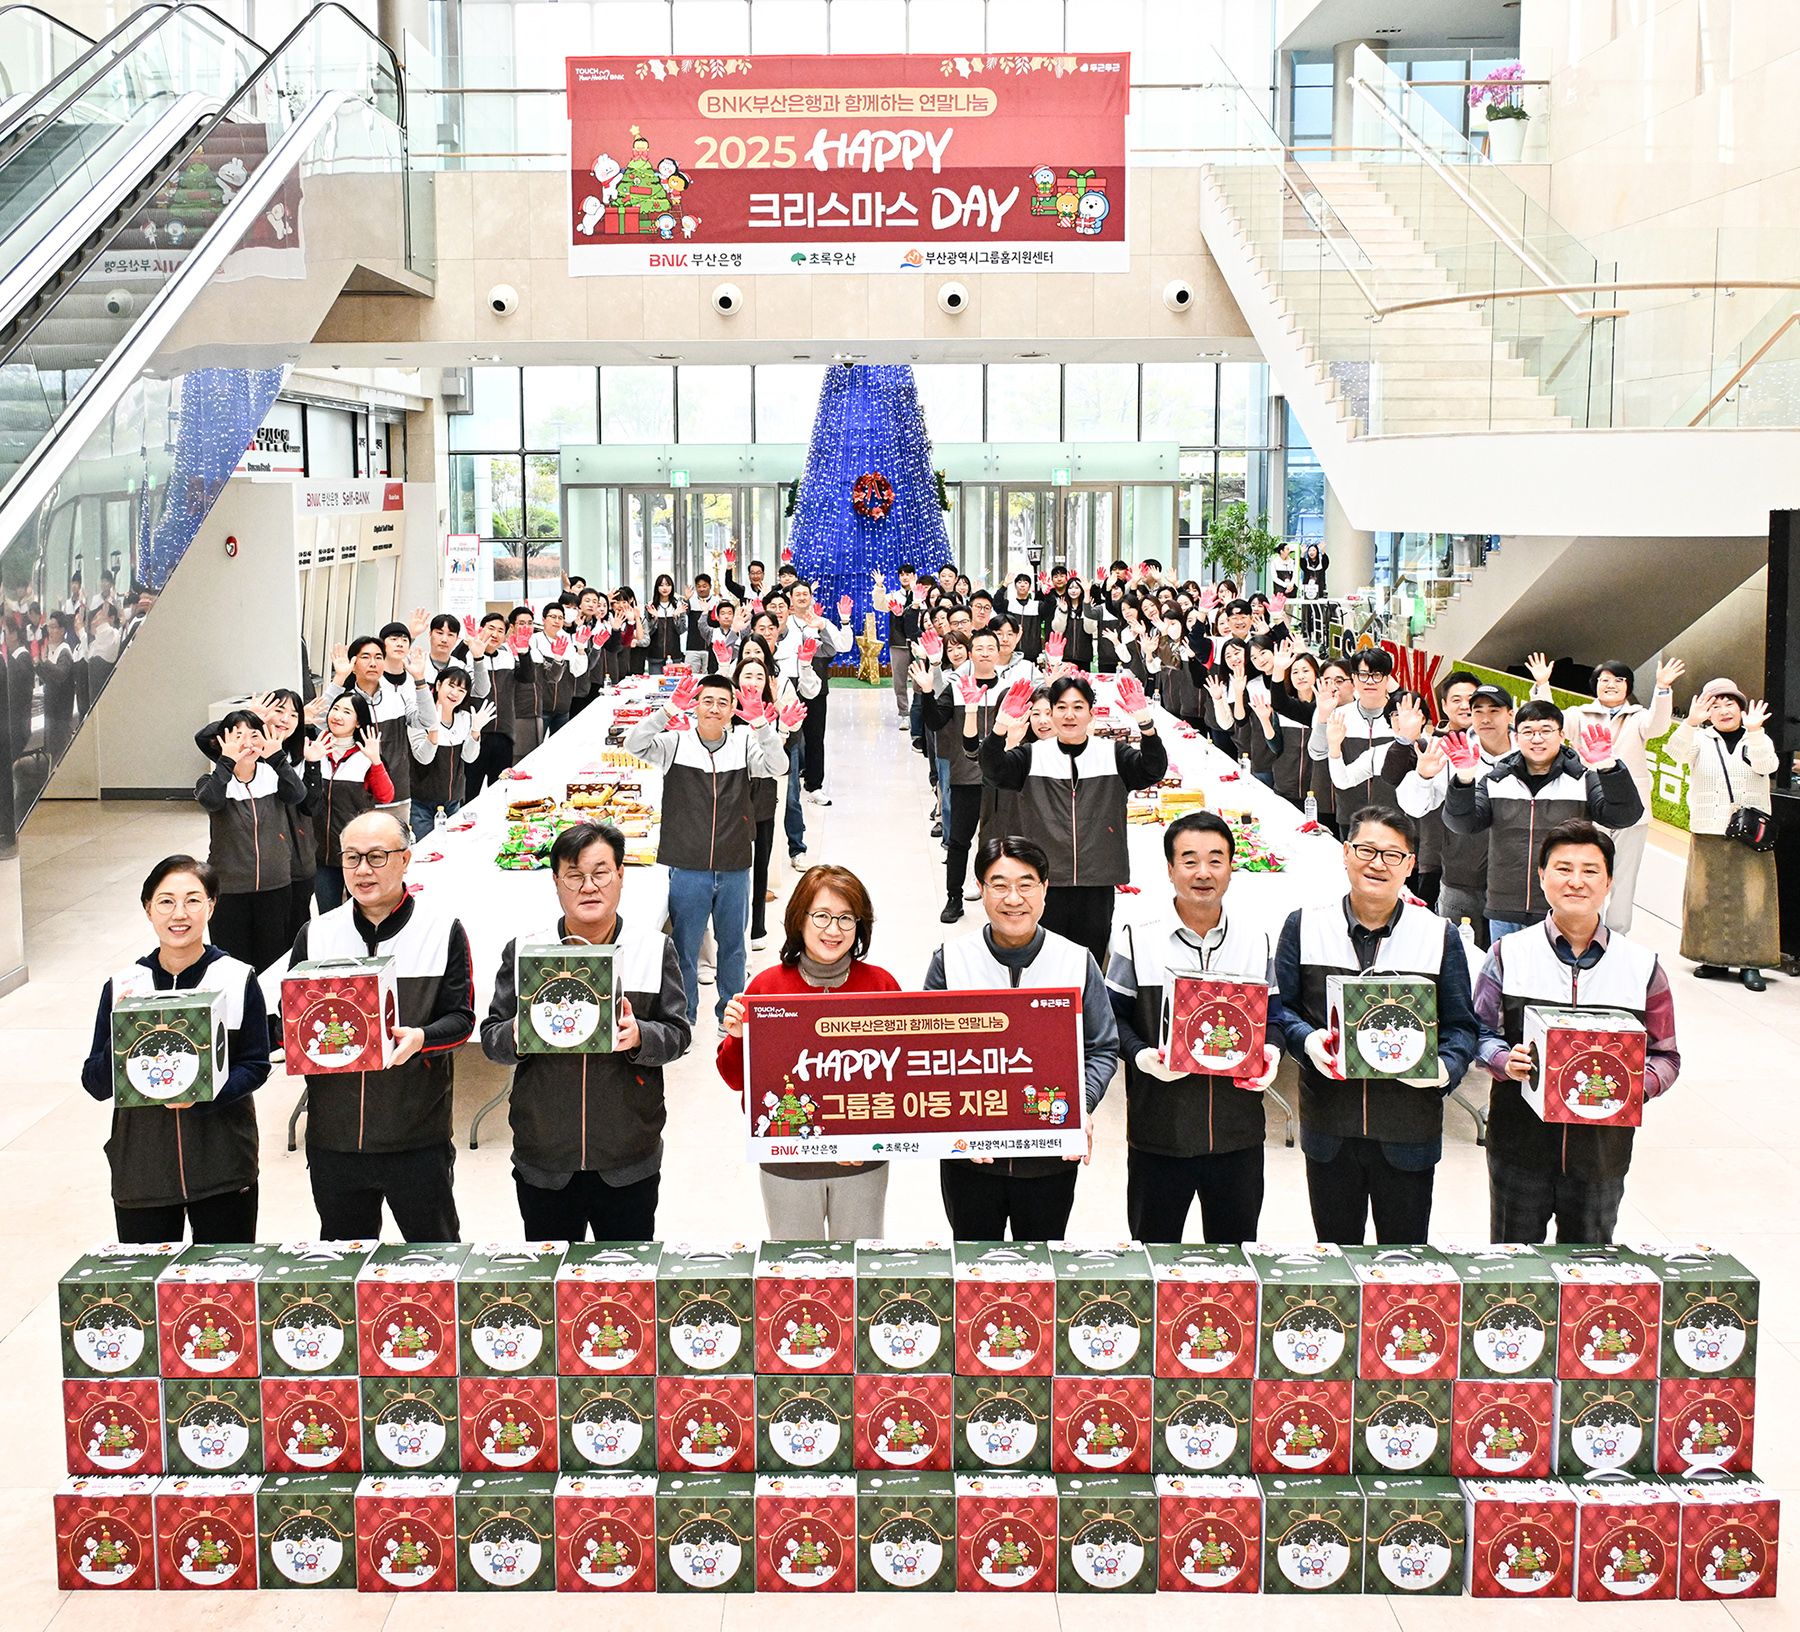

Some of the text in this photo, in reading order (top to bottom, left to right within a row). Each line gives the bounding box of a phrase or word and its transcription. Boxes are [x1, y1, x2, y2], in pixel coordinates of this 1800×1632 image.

[575, 67, 599, 75] TOUCH
[1089, 63, 1121, 72] 두근두근
[706, 93, 989, 114] BNK부산은행과 함께하는 연말나눔
[694, 127, 954, 174] 2025 HAPPY
[748, 184, 1020, 233] 크리스마스 DAY
[649, 252, 742, 267] BNK 부산은행
[808, 252, 856, 267] 초록우산
[925, 250, 1054, 266] 부산광역시그룹홈지원센터
[342, 490, 371, 506] Self-BANK
[1040, 998, 1071, 1008] 두근두근
[820, 1016, 1004, 1034] BNK부산은행과 함께하는 연말나눔
[791, 1046, 1034, 1082] HAPPY 크리스마스
[821, 1089, 1009, 1120] 그룹홈 아동 지원
[770, 1144, 838, 1156] BNK 부산은행
[885, 1142, 920, 1153] 초록우산
[969, 1138, 1063, 1152] 부산광역시그룹홈지원센터
